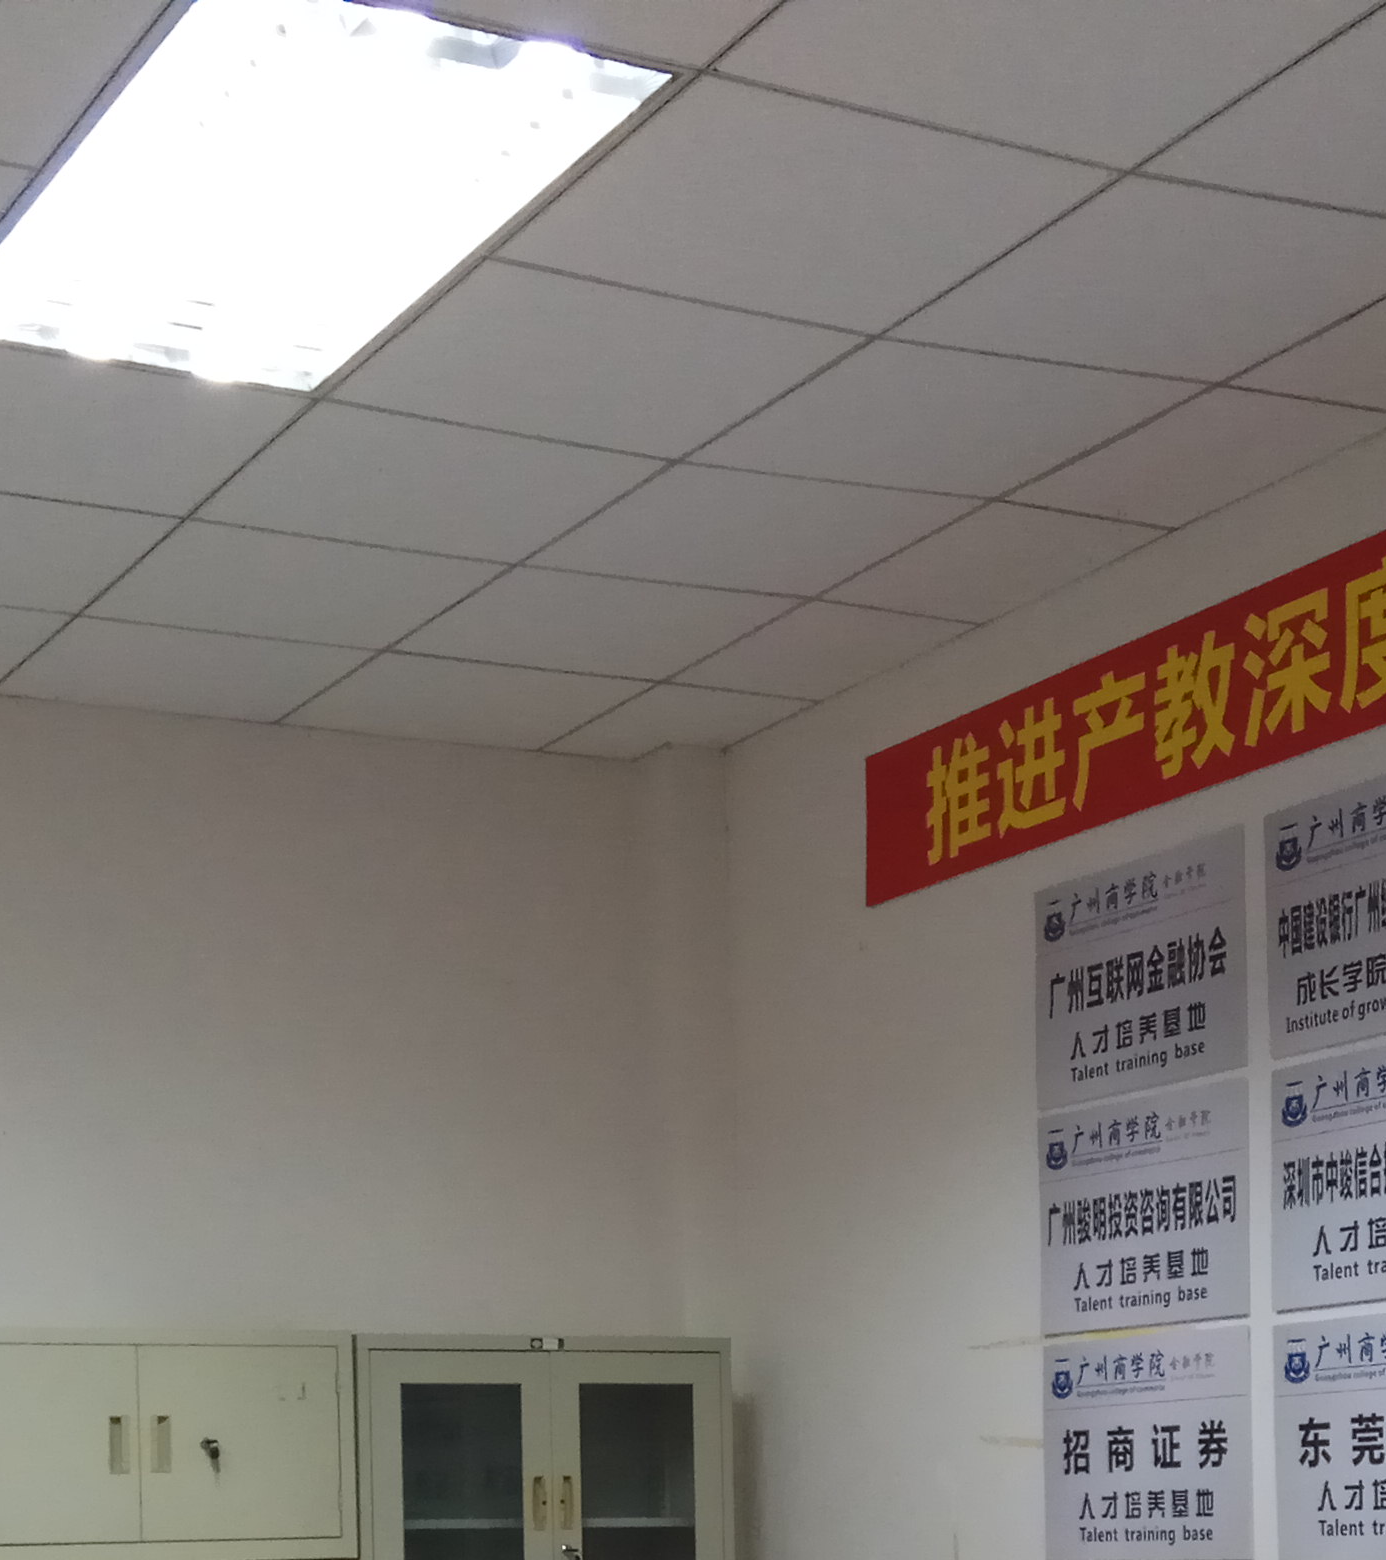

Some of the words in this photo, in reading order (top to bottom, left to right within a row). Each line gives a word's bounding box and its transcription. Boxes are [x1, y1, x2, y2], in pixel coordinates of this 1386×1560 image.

[1050, 926, 1227, 1019] 广州互联网金融协会
[1070, 1001, 1206, 1061] 人才培养基地
[1286, 1009, 1339, 1033] Institute
[1342, 1003, 1356, 1019] of
[1071, 1062, 1109, 1083] Talent
[1116, 1050, 1168, 1073] training
[1174, 1041, 1205, 1060] base
[1072, 1111, 1162, 1155] 广州商学院
[1073, 1247, 1209, 1291] 人才培养基地
[1313, 1261, 1359, 1282] Talent
[1074, 1294, 1113, 1312] Talent
[1120, 1289, 1171, 1308] training
[1178, 1285, 1209, 1302] base
[1077, 1349, 1165, 1385] 广州商学院
[1063, 1419, 1228, 1475] 招商证券
[1079, 1488, 1214, 1520] 人才培养基地
[1079, 1526, 1118, 1542] Talent
[1125, 1525, 1176, 1545] training
[1182, 1525, 1214, 1541] base
[1318, 1519, 1364, 1537] Talent
